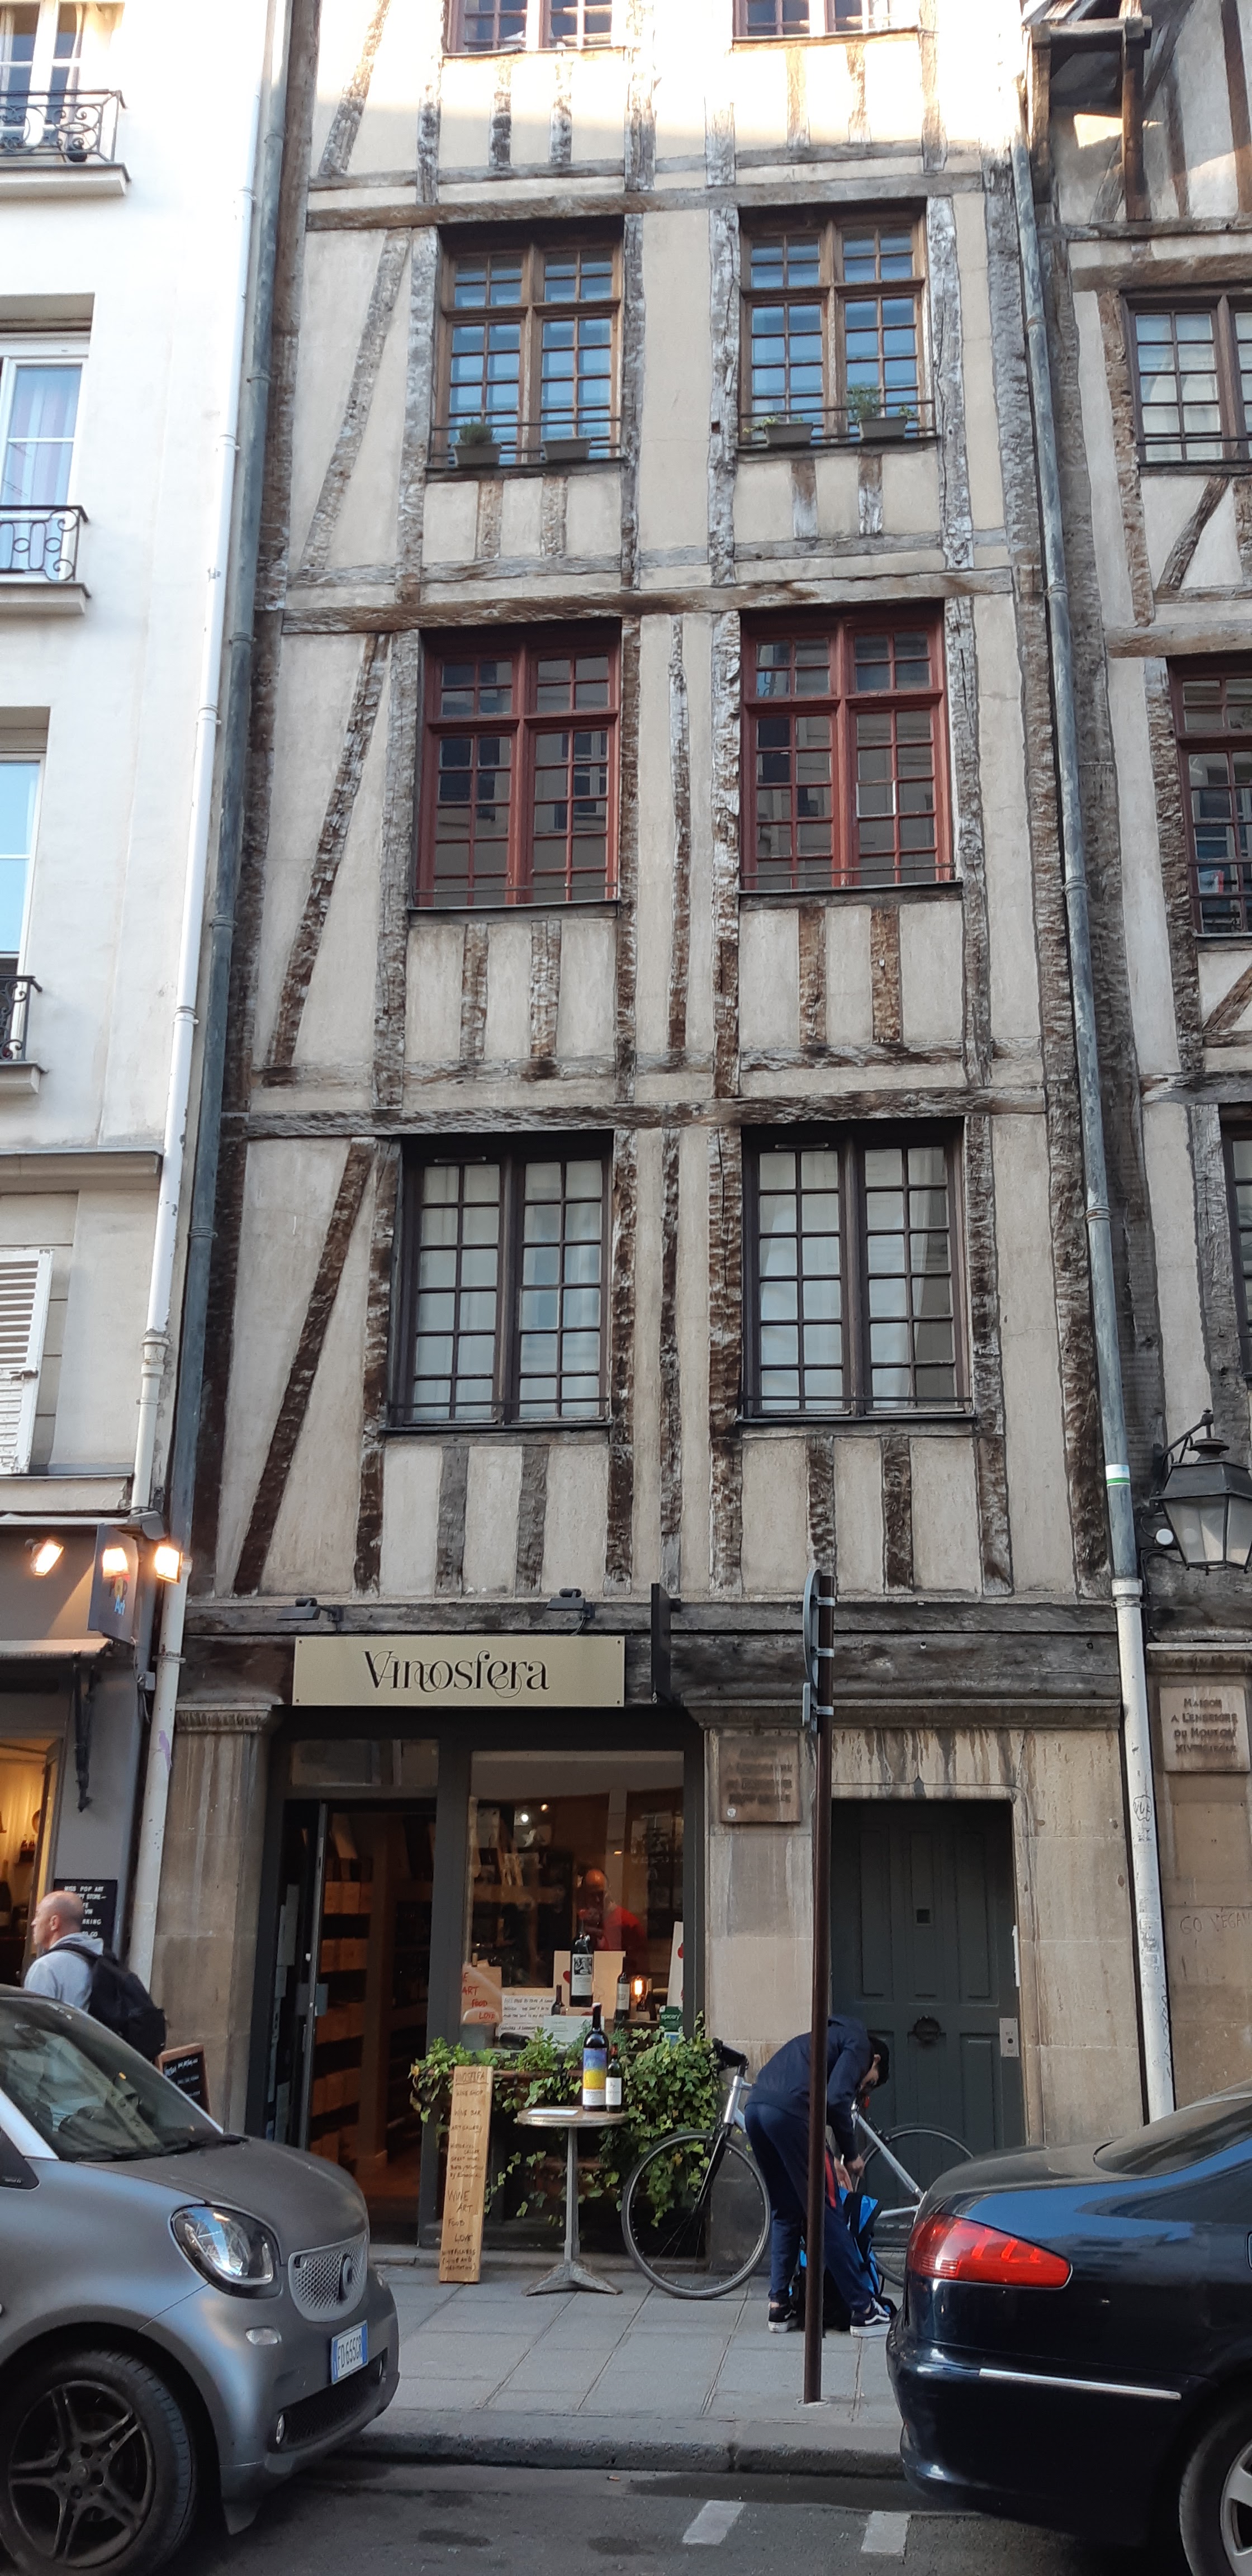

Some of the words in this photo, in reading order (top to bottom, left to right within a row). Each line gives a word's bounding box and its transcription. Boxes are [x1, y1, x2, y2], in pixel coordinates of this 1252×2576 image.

[362, 1650, 551, 1698] Vinosfera
[1180, 1915, 1202, 1935] GO
[462, 1986, 480, 1996] ART
[447, 2189, 471, 2202] WINE
[456, 2203, 473, 2213] ART
[454, 2233, 473, 2242] LOVE
